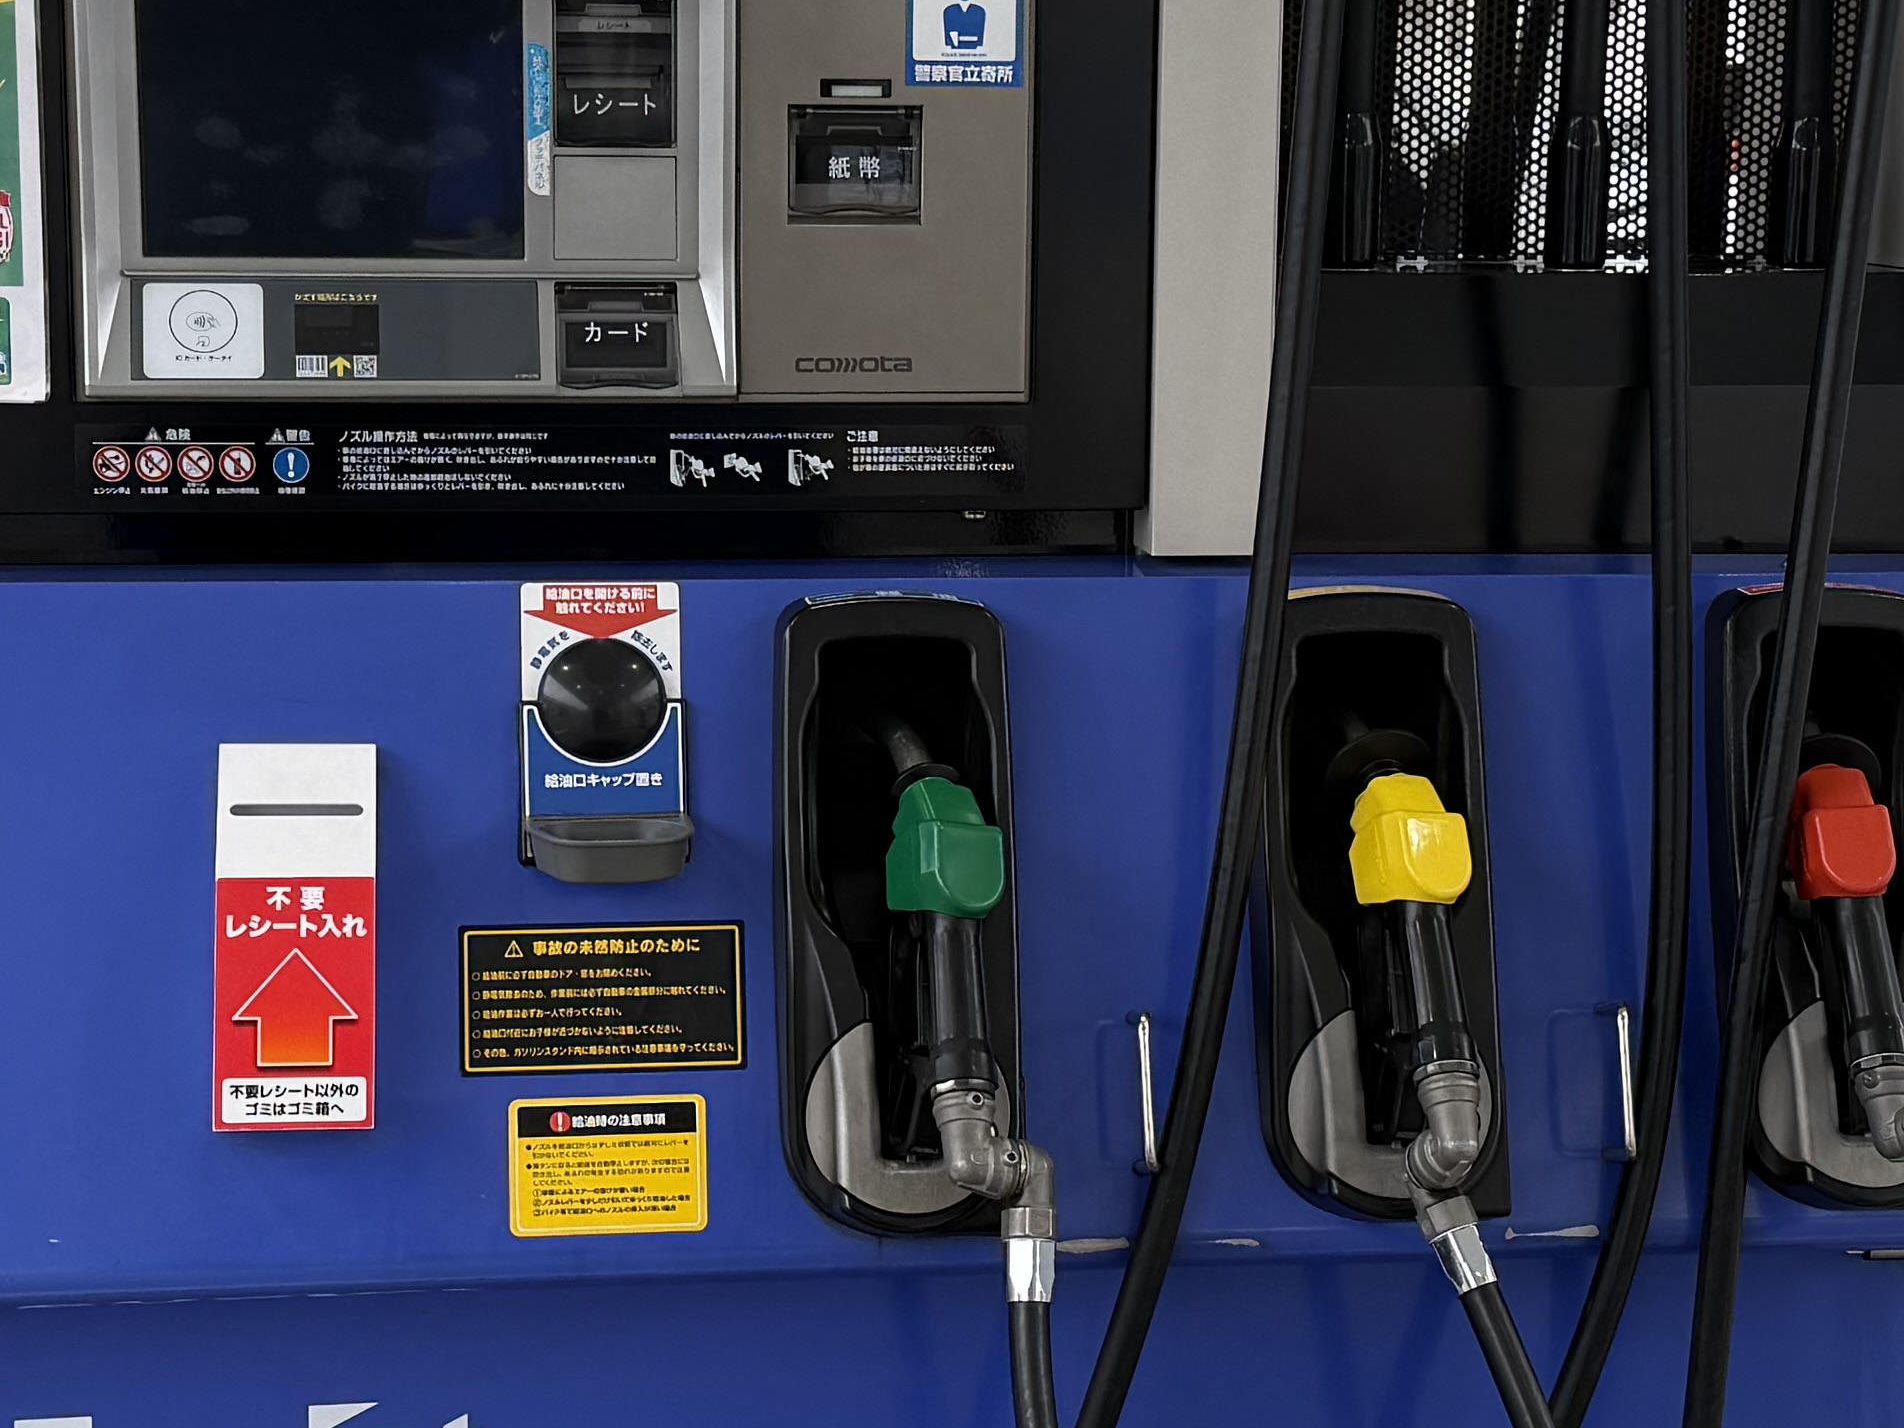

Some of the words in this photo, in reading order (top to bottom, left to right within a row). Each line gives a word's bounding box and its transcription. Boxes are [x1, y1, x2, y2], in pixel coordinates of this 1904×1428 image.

[914, 64, 1014, 84] 警察官立寄所
[574, 93, 657, 116] レシート
[828, 156, 880, 179] 紙幣
[584, 321, 649, 343] カード
[165, 428, 191, 441] 危険
[545, 587, 656, 601] 給油口を開ける前に
[544, 772, 663, 789] 給油口キャップ置き
[266, 886, 325, 911] 不要
[225, 913, 368, 938] レシート入れ
[533, 938, 701, 956] 事故の未然防止のために
[229, 1083, 359, 1100] 不要レシート以外の
[245, 1101, 344, 1117] ゴミはゴミ箱へ
[572, 1113, 666, 1128] 給油時の注意事項
